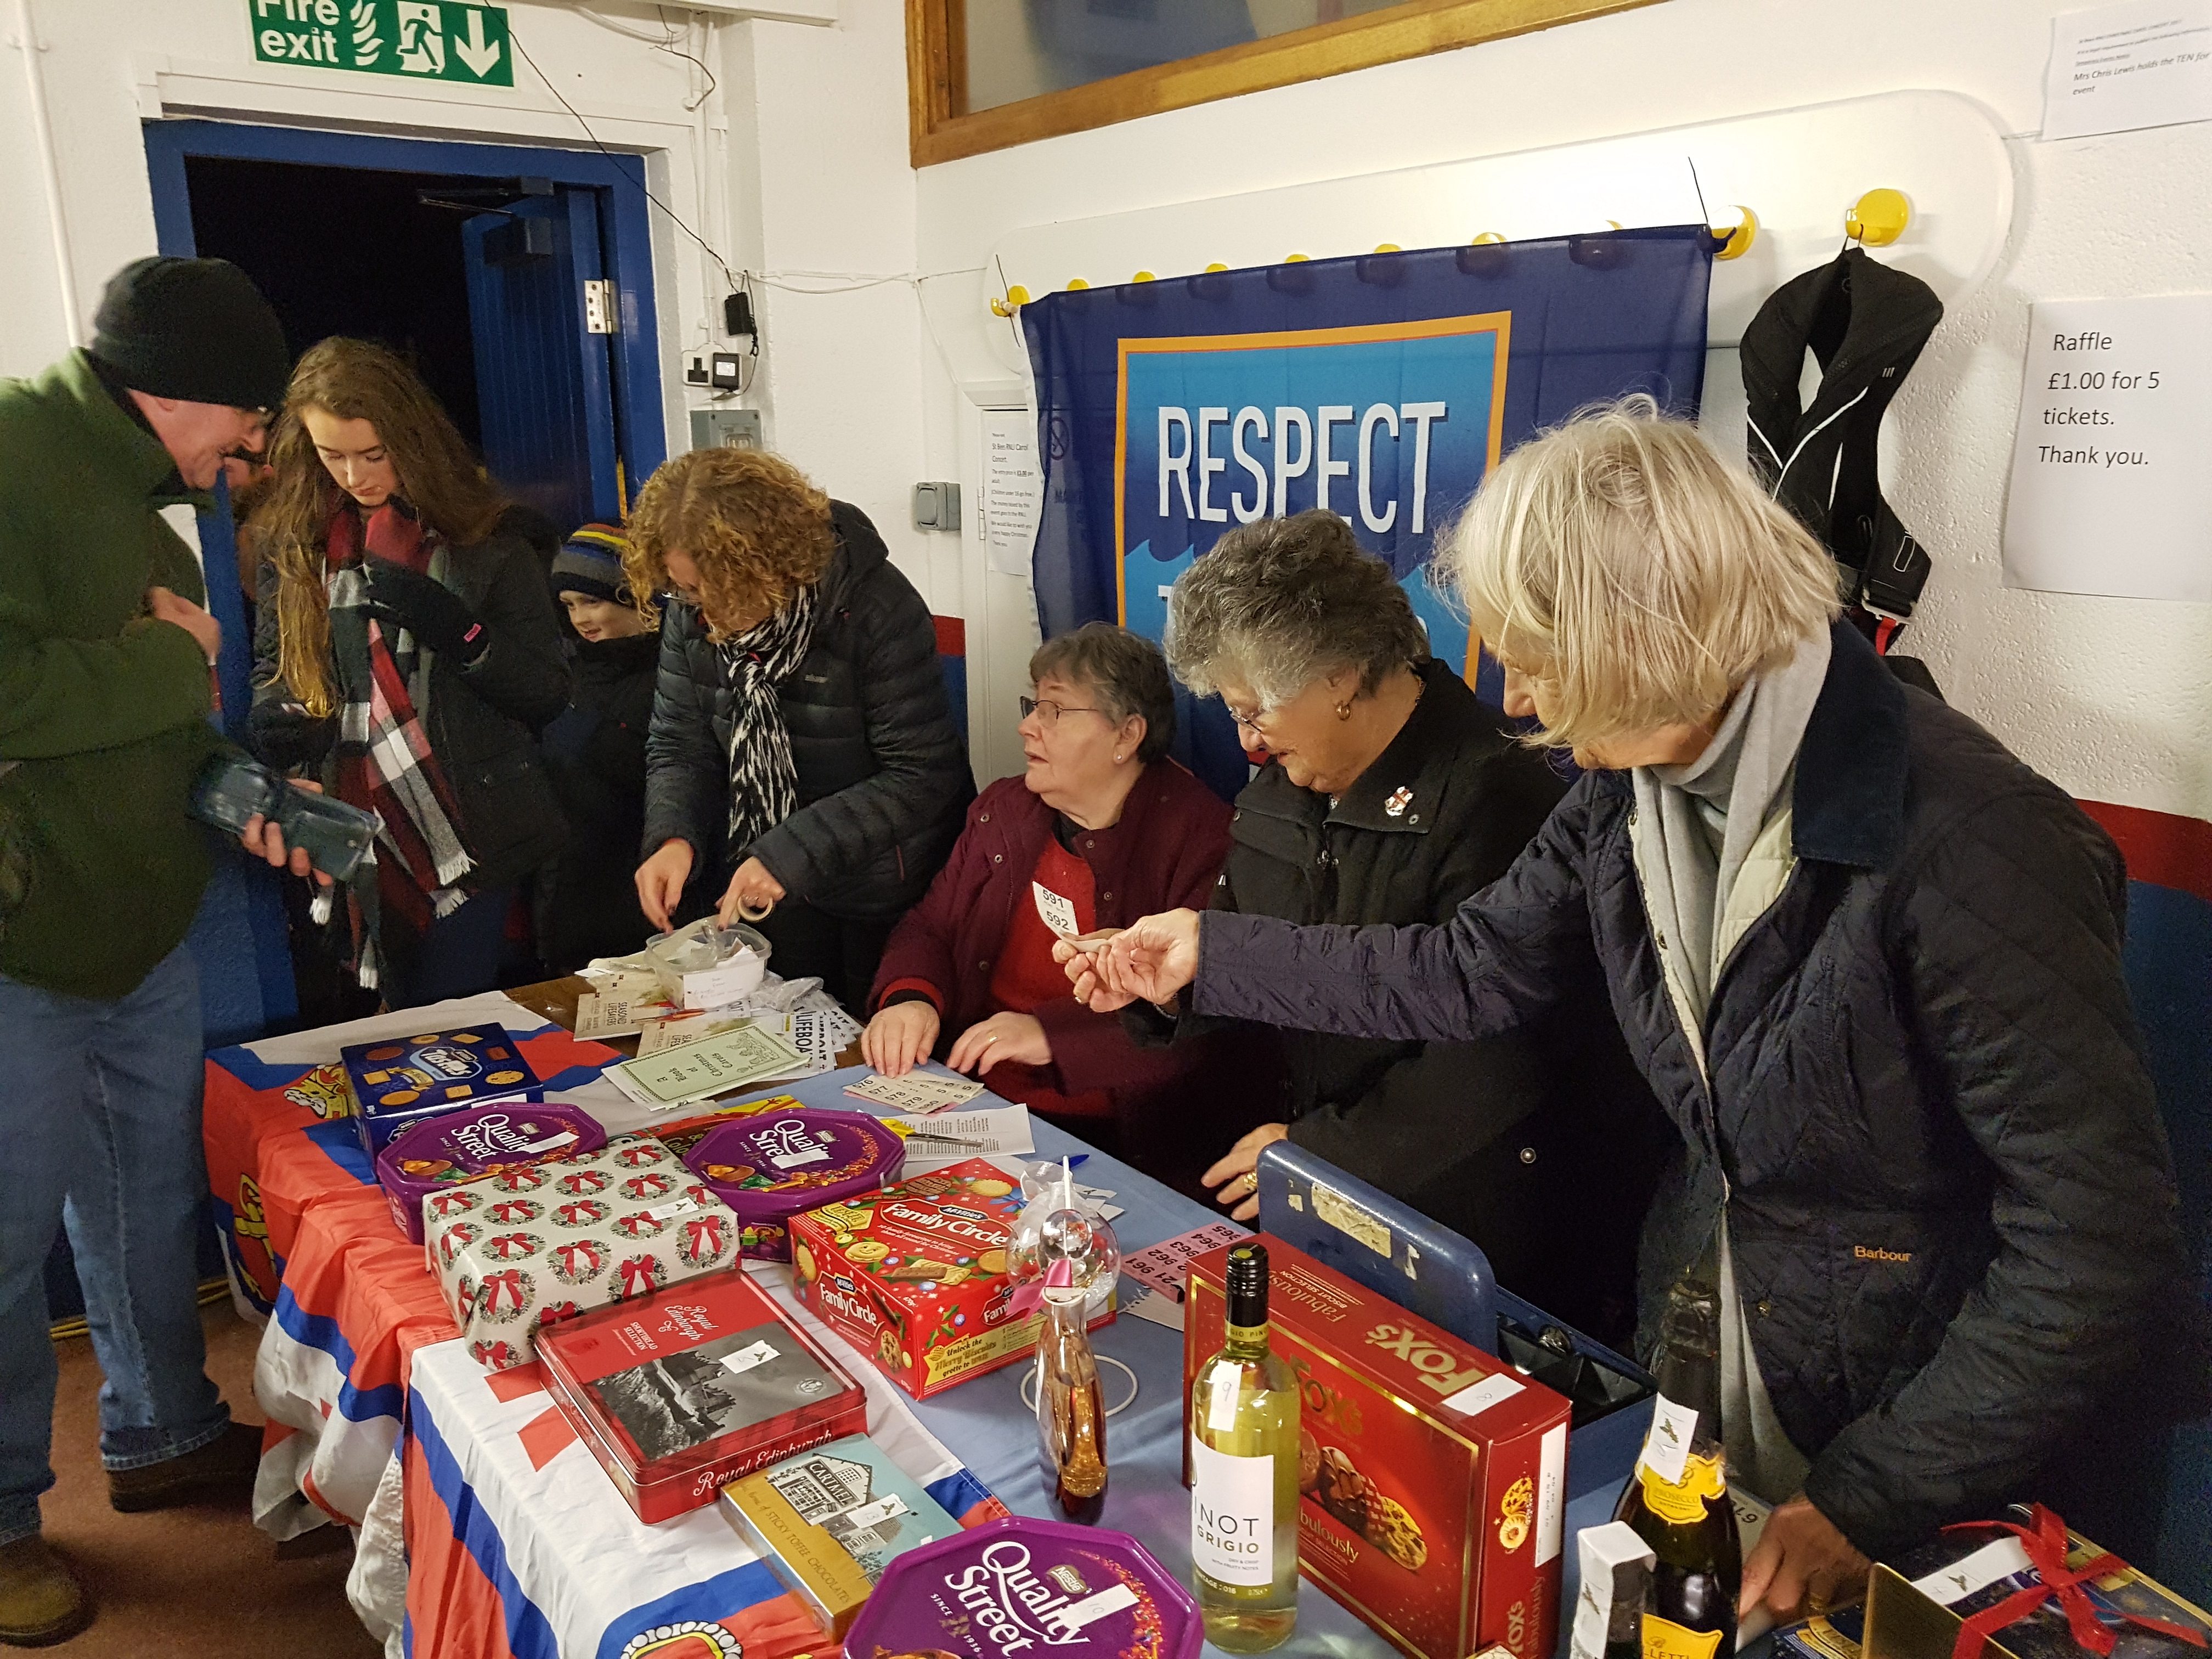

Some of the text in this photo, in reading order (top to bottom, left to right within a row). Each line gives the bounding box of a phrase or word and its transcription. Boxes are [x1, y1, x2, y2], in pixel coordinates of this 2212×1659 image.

[261, 27, 339, 63] exit
[2073, 73, 2090, 81] Mrs
[2092, 69, 2112, 78] Chris
[2114, 66, 2135, 75] Lewis
[2137, 60, 2158, 70] holds
[2160, 58, 2174, 66] the
[2176, 53, 2195, 63] TEN
[2195, 52, 2210, 62] for
[2072, 85, 2096, 95] event
[2053, 332, 2112, 351] Raffle
[2048, 371, 2160, 390] £1.00 for 5
[2044, 407, 2115, 426] tickets.
[1159, 401, 1446, 534] RESPECT
[2038, 445, 2149, 468] Thank you.
[1042, 888, 1064, 909] 591
[1046, 911, 1070, 930] 592
[606, 1002, 616, 1026] LIFESAVERS
[617, 1002, 628, 1025] SEASONED
[794, 1011, 814, 1054] LIFEBOA
[693, 1052, 724, 1077] Christmas
[709, 1052, 734, 1069] Carols
[669, 1066, 688, 1083] Book
[852, 1079, 874, 1090] 576
[868, 1085, 889, 1096] 577
[884, 1091, 906, 1102] 578
[901, 1096, 923, 1108] 579
[450, 1124, 497, 1161] Street
[739, 1141, 752, 1154] SINCE
[882, 1203, 950, 1230] Family
[947, 1220, 1008, 1245] Circle
[1169, 1241, 1200, 1257] 963
[1190, 1233, 1222, 1249] 964
[1148, 1249, 1175, 1266] 962
[1854, 1245, 1912, 1262] Barbour
[1125, 1257, 1155, 1274] 961
[1279, 1269, 1319, 1294] SELECTION
[820, 1283, 877, 1327] Family Circle
[1316, 1286, 1348, 1309] BISCUIT
[664, 1304, 703, 1341] Edinburgh
[682, 1305, 717, 1331] Royal
[623, 1325, 648, 1352] SELECTION
[629, 1321, 658, 1351] SHORTBREAD
[946, 1338, 983, 1357] Unlock the
[934, 1356, 962, 1372] Merry
[1222, 1380, 1232, 1402] 9
[693, 1431, 833, 1497] Royal Edinburgh
[809, 1463, 856, 1505] CARTMEL
[1193, 1496, 1260, 1537] INOT
[1197, 1523, 1259, 1554] GRIGIO
[1300, 1506, 1359, 1563] bulously
[765, 1510, 788, 1534] STICKY
[788, 1534, 810, 1559] TOFFEE
[807, 1558, 853, 1603] CHOCOLATES
[981, 1541, 1091, 1647] Quality
[944, 1565, 1036, 1657] Street
[929, 1593, 982, 1654] SINCE 1936
